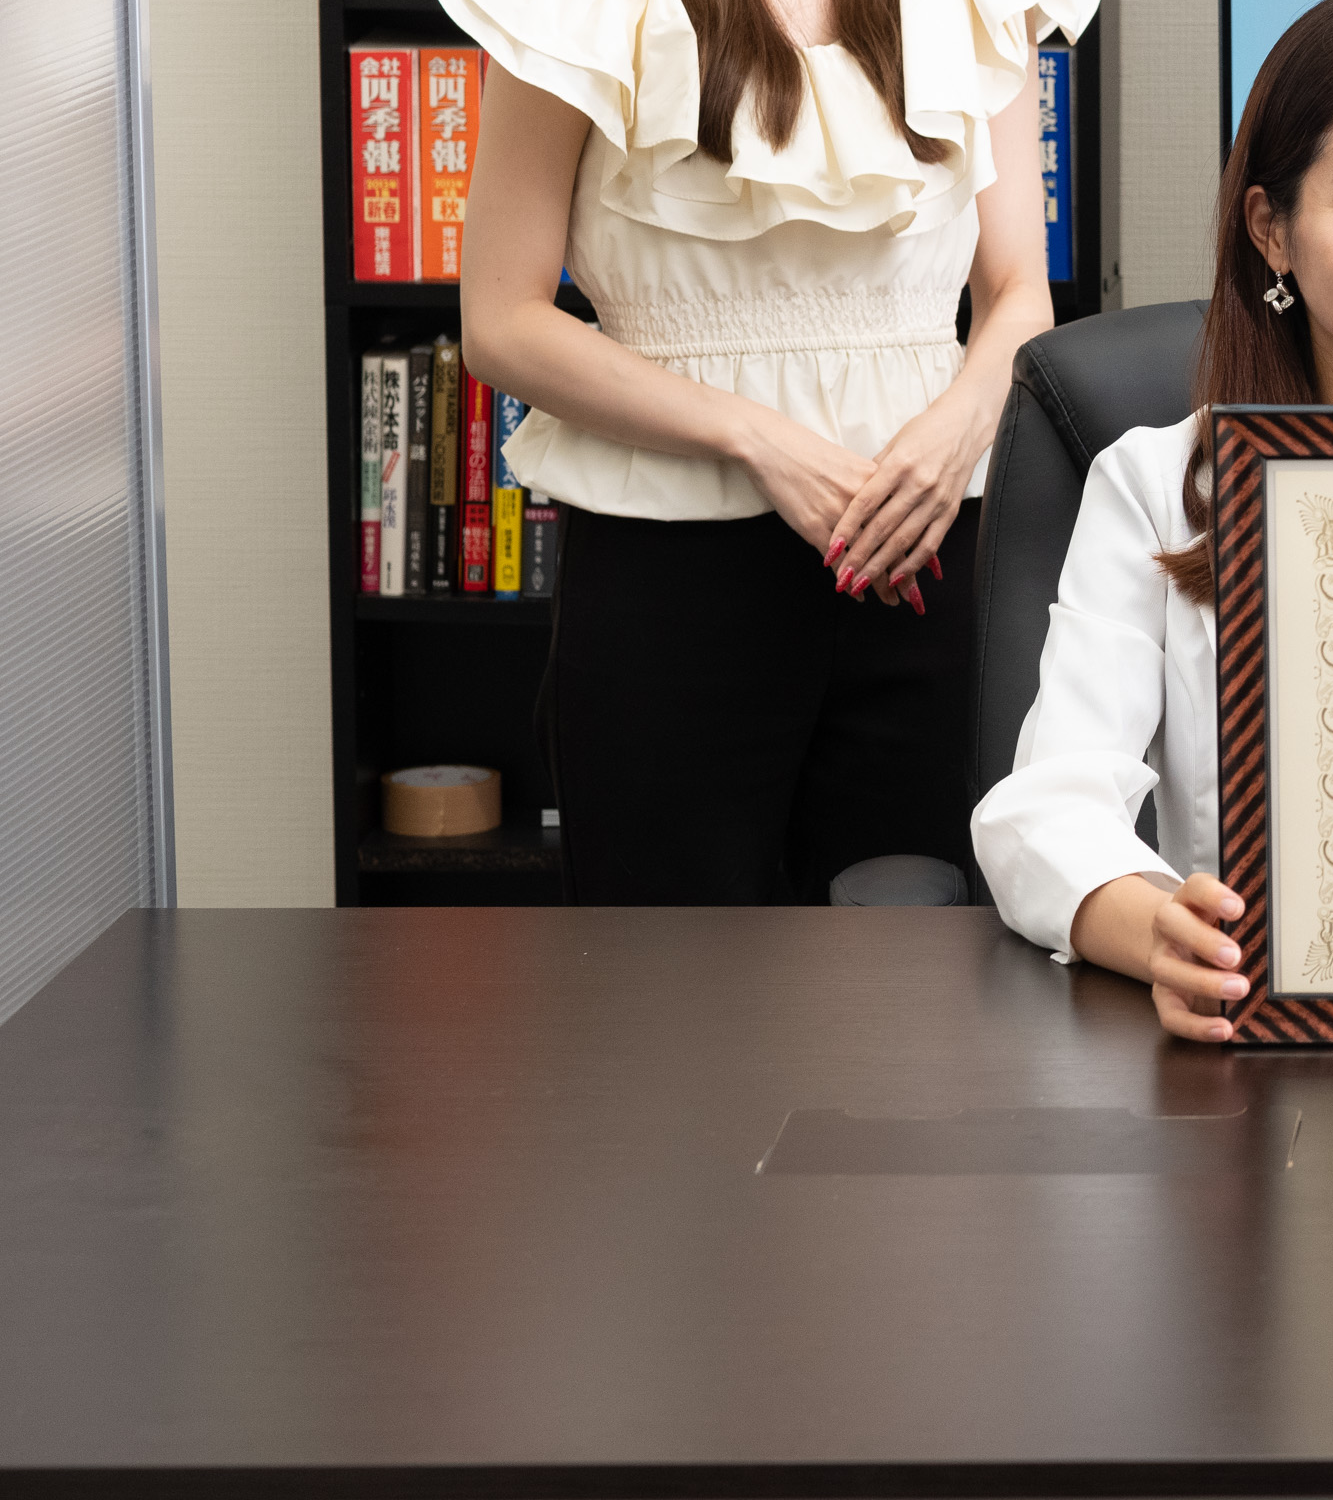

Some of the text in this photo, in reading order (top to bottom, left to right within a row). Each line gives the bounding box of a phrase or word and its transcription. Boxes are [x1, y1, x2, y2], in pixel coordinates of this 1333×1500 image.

[367, 201, 397, 219] 新春
[439, 201, 460, 219] 秋
[384, 370, 400, 450] 株が本命
